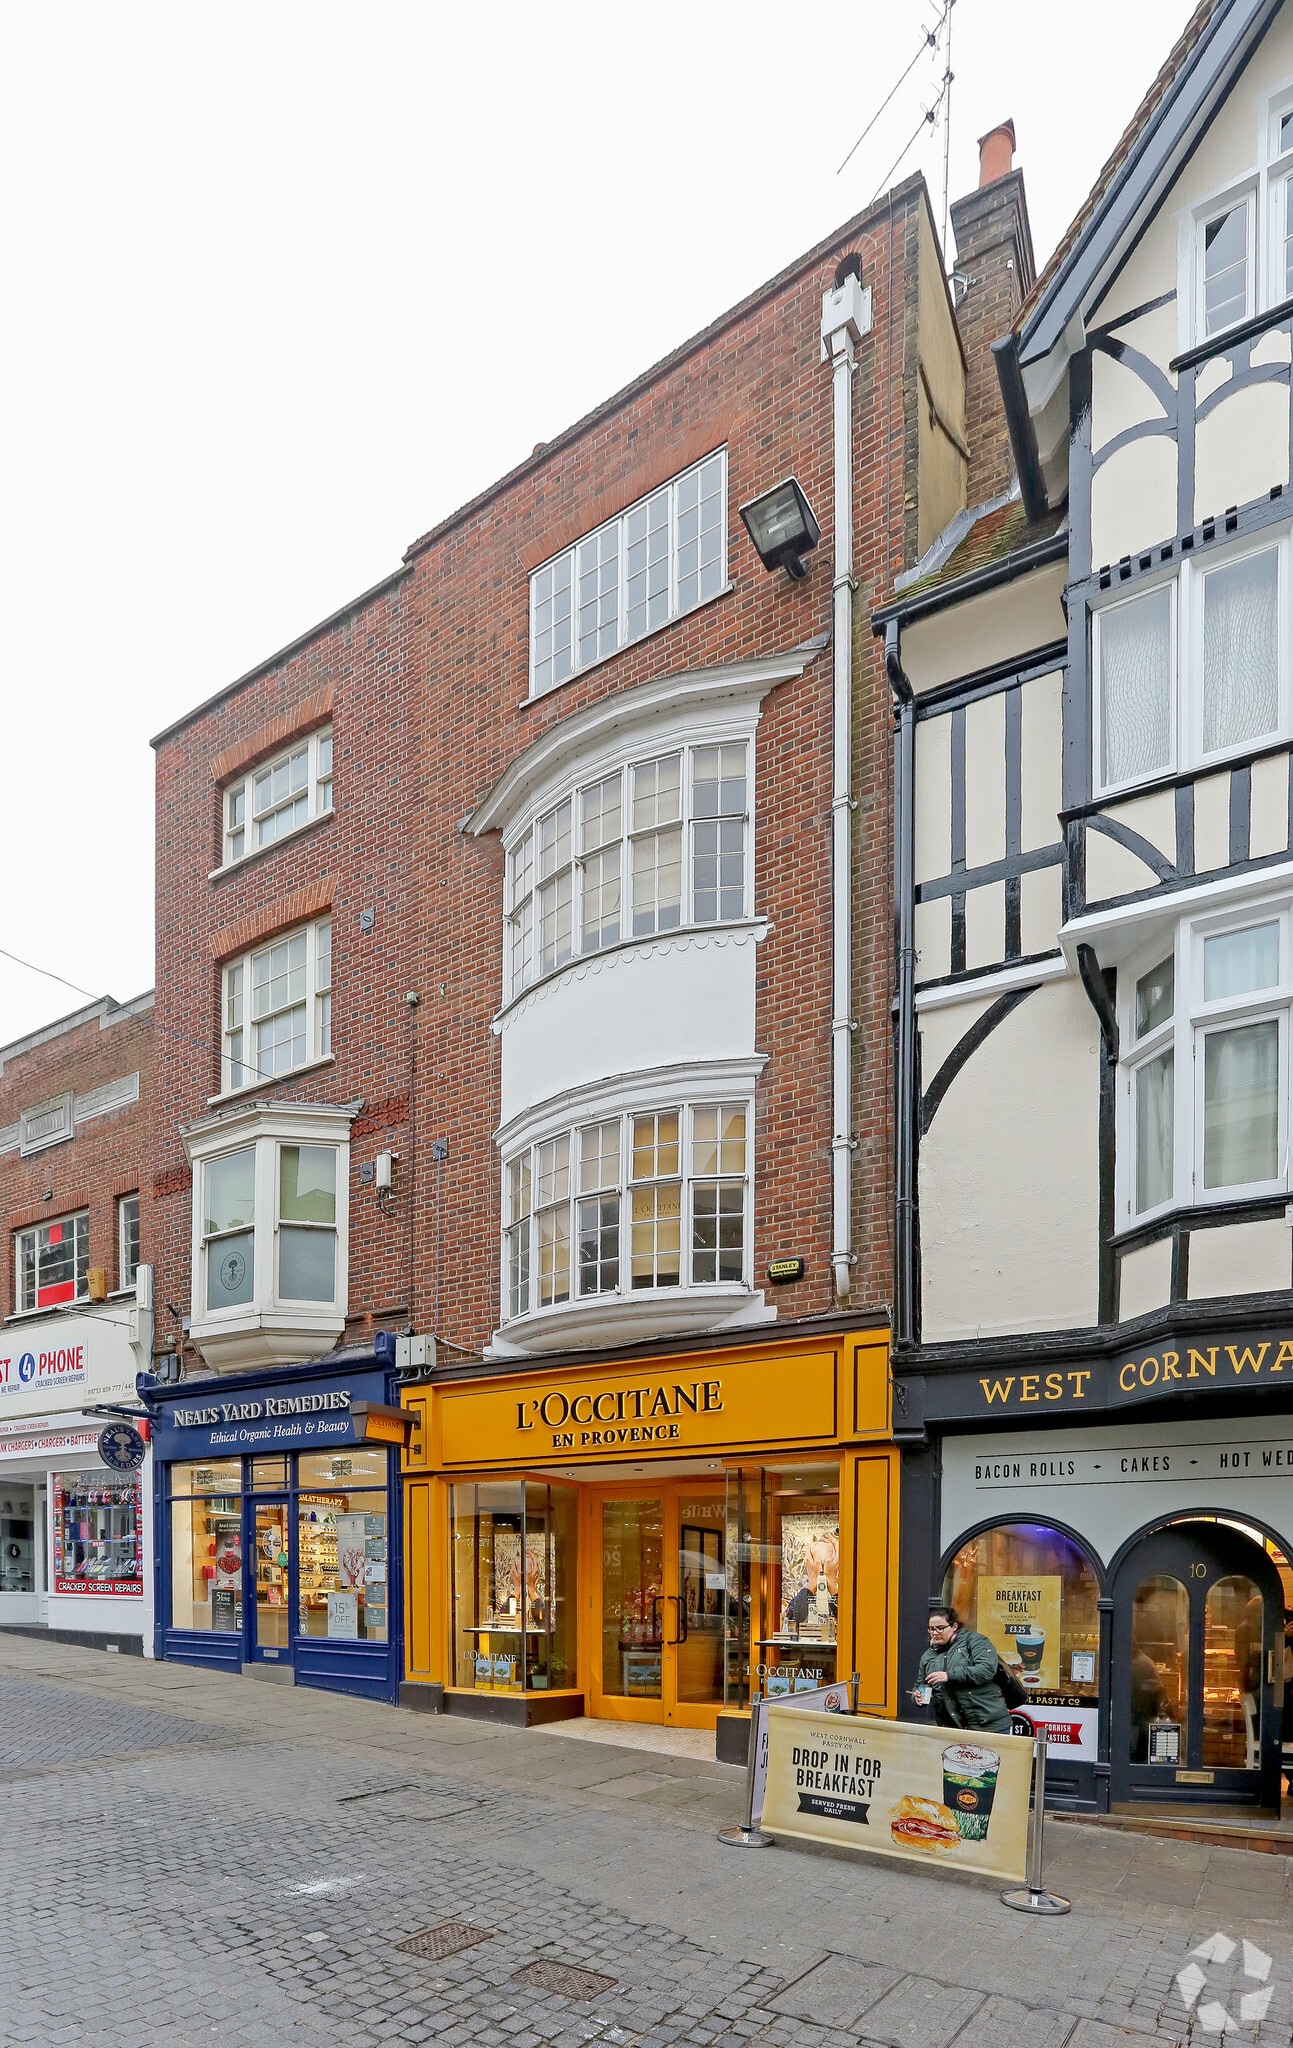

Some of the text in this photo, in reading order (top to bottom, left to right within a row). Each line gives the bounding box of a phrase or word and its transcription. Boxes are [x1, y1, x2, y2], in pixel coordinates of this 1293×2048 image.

[771, 1262, 797, 1270] STANLEY
[39, 1346, 84, 1375] PHONE
[35, 1373, 85, 1388] CRACKED SCREEN REPAIRS
[979, 1371, 1091, 1404] WEST
[173, 1391, 351, 1428] NEAL'S YARD REMEDIES
[516, 1381, 723, 1430] L'OCCITANE
[103, 1426, 124, 1444] NEAL'S
[210, 1420, 350, 1444] Ethical Organic Health & Beauty
[552, 1424, 680, 1447] EN PROVENCE
[8, 1440, 34, 1452] CHARGERS
[38, 1437, 66, 1449] CHARGERS
[105, 1452, 142, 1468] REMEDIES
[975, 1463, 1021, 1480] BACON
[1030, 1461, 1075, 1477] ROLLS
[1120, 1456, 1171, 1473] CAKES
[1220, 1452, 1251, 1468] HOT
[1189, 1563, 1207, 1579] 10
[58, 1582, 141, 1593] CRACKED SCREEN REPAIRS
[996, 1590, 1042, 1601] BREAKFAST
[334, 1601, 351, 1615] 15%
[1008, 1602, 1028, 1613] DEAL
[334, 1615, 350, 1624] OFF
[1009, 1625, 1026, 1634] £3.25
[746, 1663, 824, 1680] L'OCCITANE
[1036, 1696, 1065, 1705] PASTY
[810, 1731, 867, 1745] WEST CORNWALL
[822, 1741, 842, 1749] PASTY
[792, 1747, 881, 1778] DROP IN FOR
[796, 1768, 875, 1798] BREAKFAST
[811, 1799, 856, 1812] SERVED FRESH
[824, 1807, 843, 1815] DAILY
